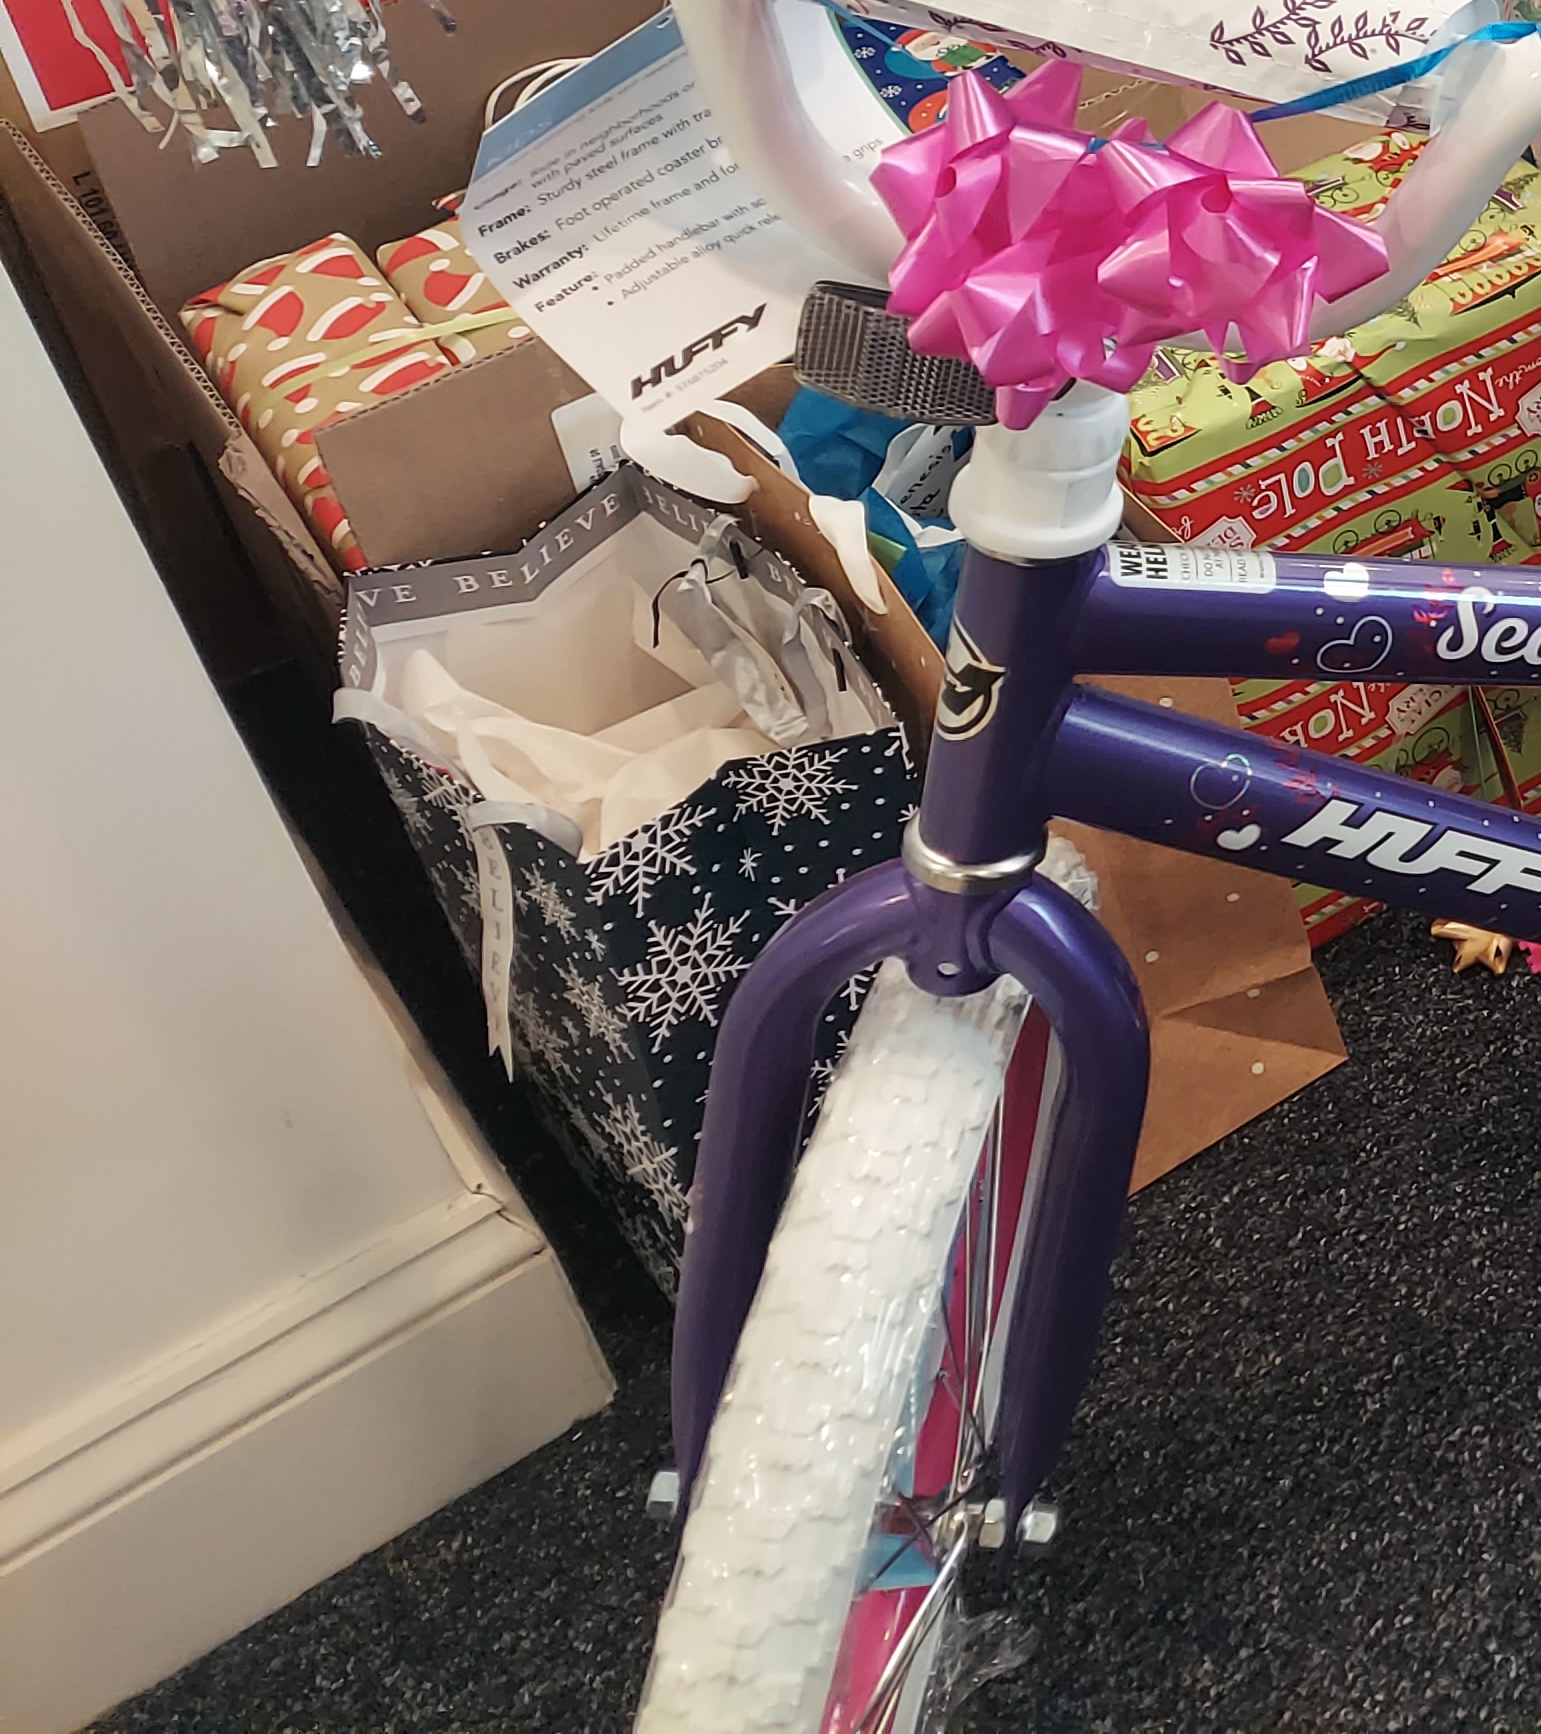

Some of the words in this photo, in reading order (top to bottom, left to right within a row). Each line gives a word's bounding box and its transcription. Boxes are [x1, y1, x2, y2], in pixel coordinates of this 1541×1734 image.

[477, 204, 532, 238] Frame:
[537, 177, 582, 207] Sturdy
[584, 153, 619, 180] steel
[619, 136, 660, 163] frame
[660, 118, 692, 139] with
[531, 166, 561, 190] with
[564, 143, 607, 176] paved
[609, 113, 664, 148] surfaces
[493, 230, 551, 266] Brakes:
[555, 206, 591, 232] Foot
[592, 169, 656, 213] operated
[656, 144, 707, 178] coaster
[512, 243, 590, 290] Warranty:
[592, 205, 652, 244] Lifetime
[648, 186, 692, 211] frame
[694, 171, 721, 192] and
[534, 269, 599, 314] Feature:
[603, 247, 657, 285] Padded
[655, 216, 721, 255] handlebar
[722, 204, 749, 224] with
[621, 255, 691, 301] Adjustable
[691, 238, 722, 260] alloy
[723, 225, 757, 246] quick
[630, 302, 767, 401] HUFFY
[1361, 366, 1504, 460] NORTH
[1250, 430, 1353, 521] POLE
[453, 493, 621, 595] BELIEVE
